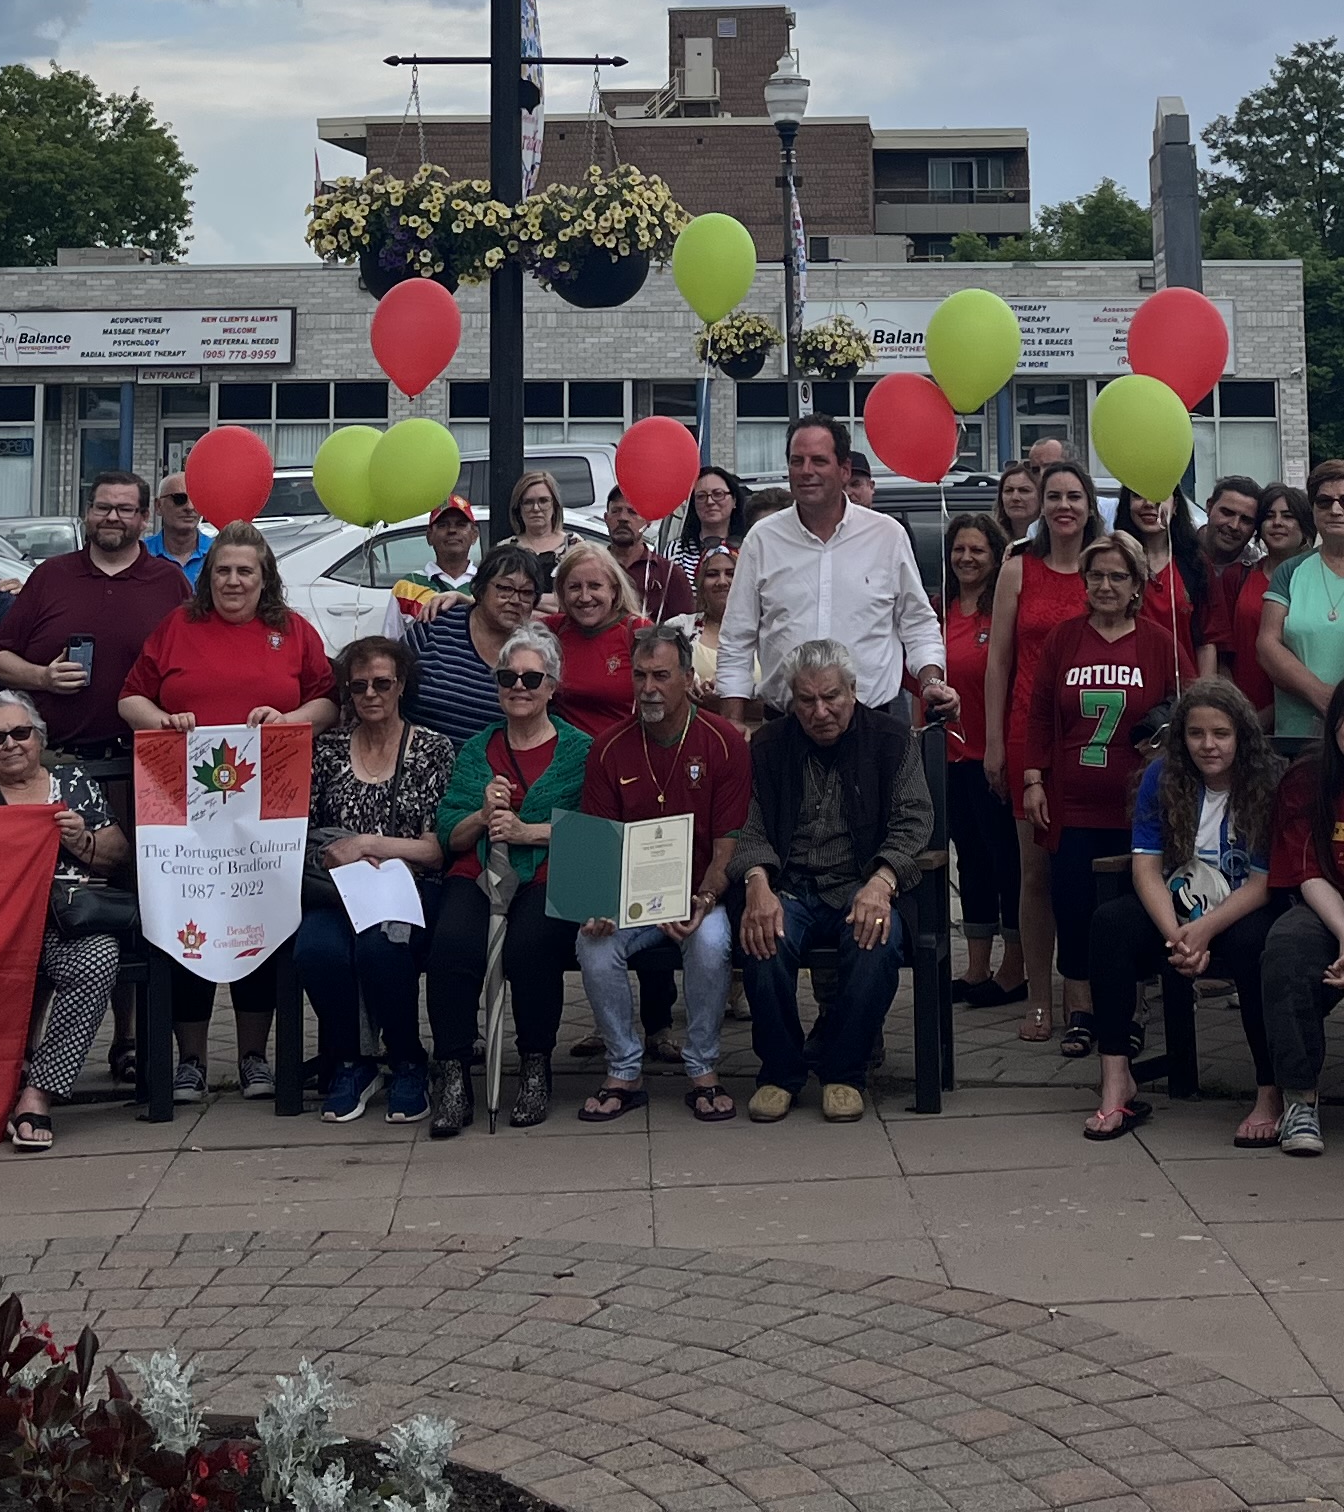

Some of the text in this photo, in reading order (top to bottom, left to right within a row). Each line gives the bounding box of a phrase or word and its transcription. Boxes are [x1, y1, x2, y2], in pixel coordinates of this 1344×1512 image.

[110, 316, 163, 324] ACUPUNCTURE
[218, 315, 249, 323] CLIENTS
[138, 327, 171, 335] THERAPY
[872, 329, 925, 344] Balan
[18, 332, 72, 344] Balance
[112, 339, 160, 347] PSYCHOLOGY
[201, 338, 212, 346] NO
[108, 350, 152, 358] SHOCKWAVE
[154, 350, 187, 358] THERAPY
[202, 349, 277, 360] (905) 778-9959
[142, 370, 196, 380] ENTRANCE
[1065, 664, 1144, 688] ORTUGA
[1079, 688, 1127, 768] 7
[141, 837, 301, 861] The Portuguese Cultural
[160, 855, 282, 876] Centre of Bradford
[181, 882, 215, 899] 1987
[230, 879, 264, 898] 2022
[226, 923, 264, 936] Bradford
